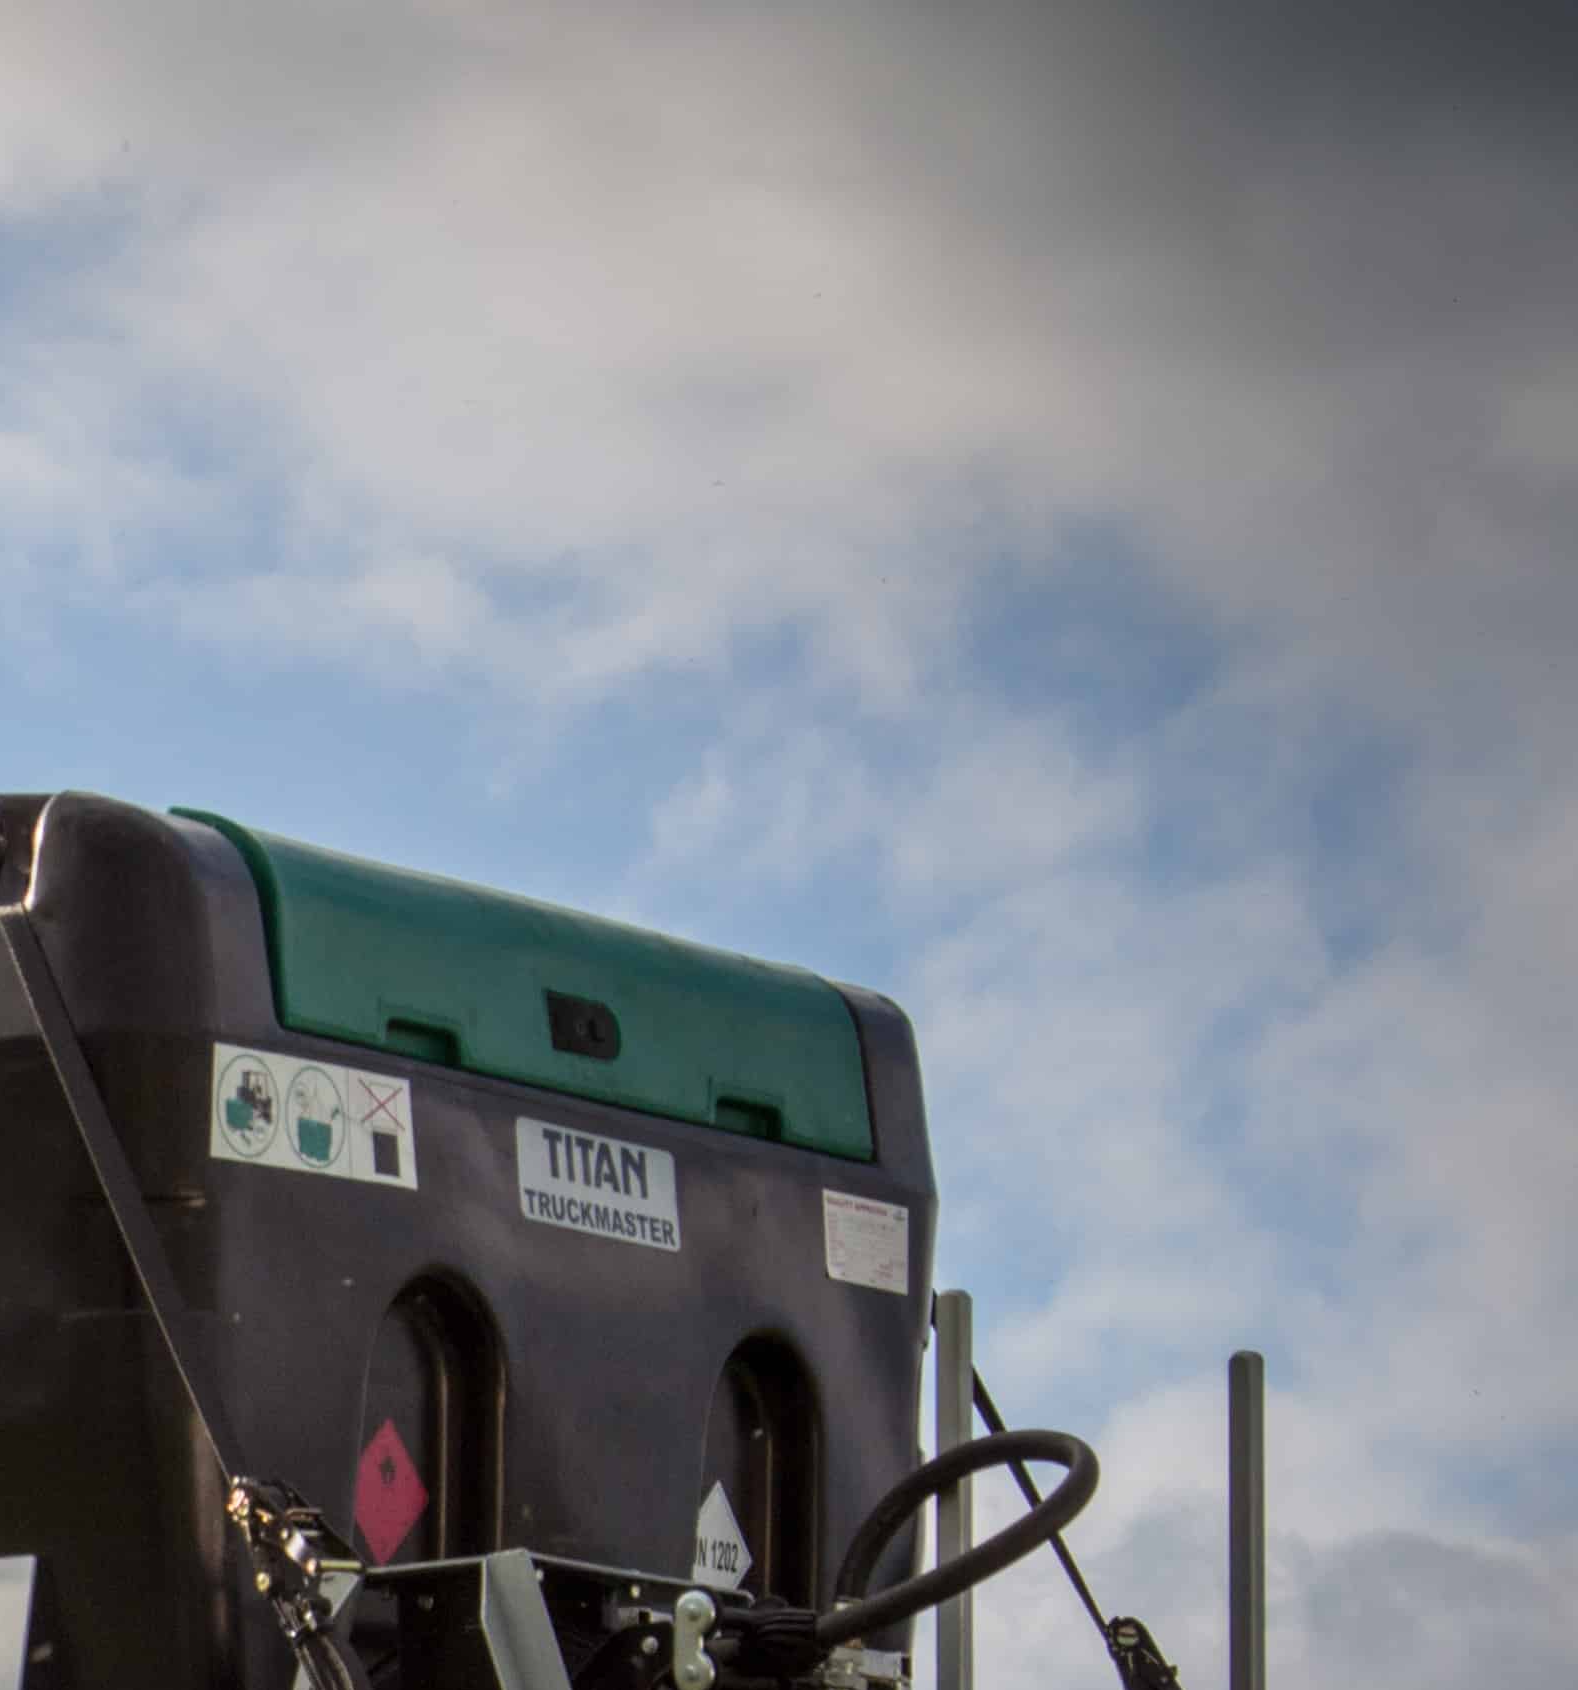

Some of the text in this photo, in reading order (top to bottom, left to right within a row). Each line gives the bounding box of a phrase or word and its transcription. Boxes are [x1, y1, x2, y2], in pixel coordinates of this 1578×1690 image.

[543, 1127, 648, 1200] TITAN
[523, 1187, 677, 1247] TRUCKMASTER
[711, 1540, 739, 1574] 1202
